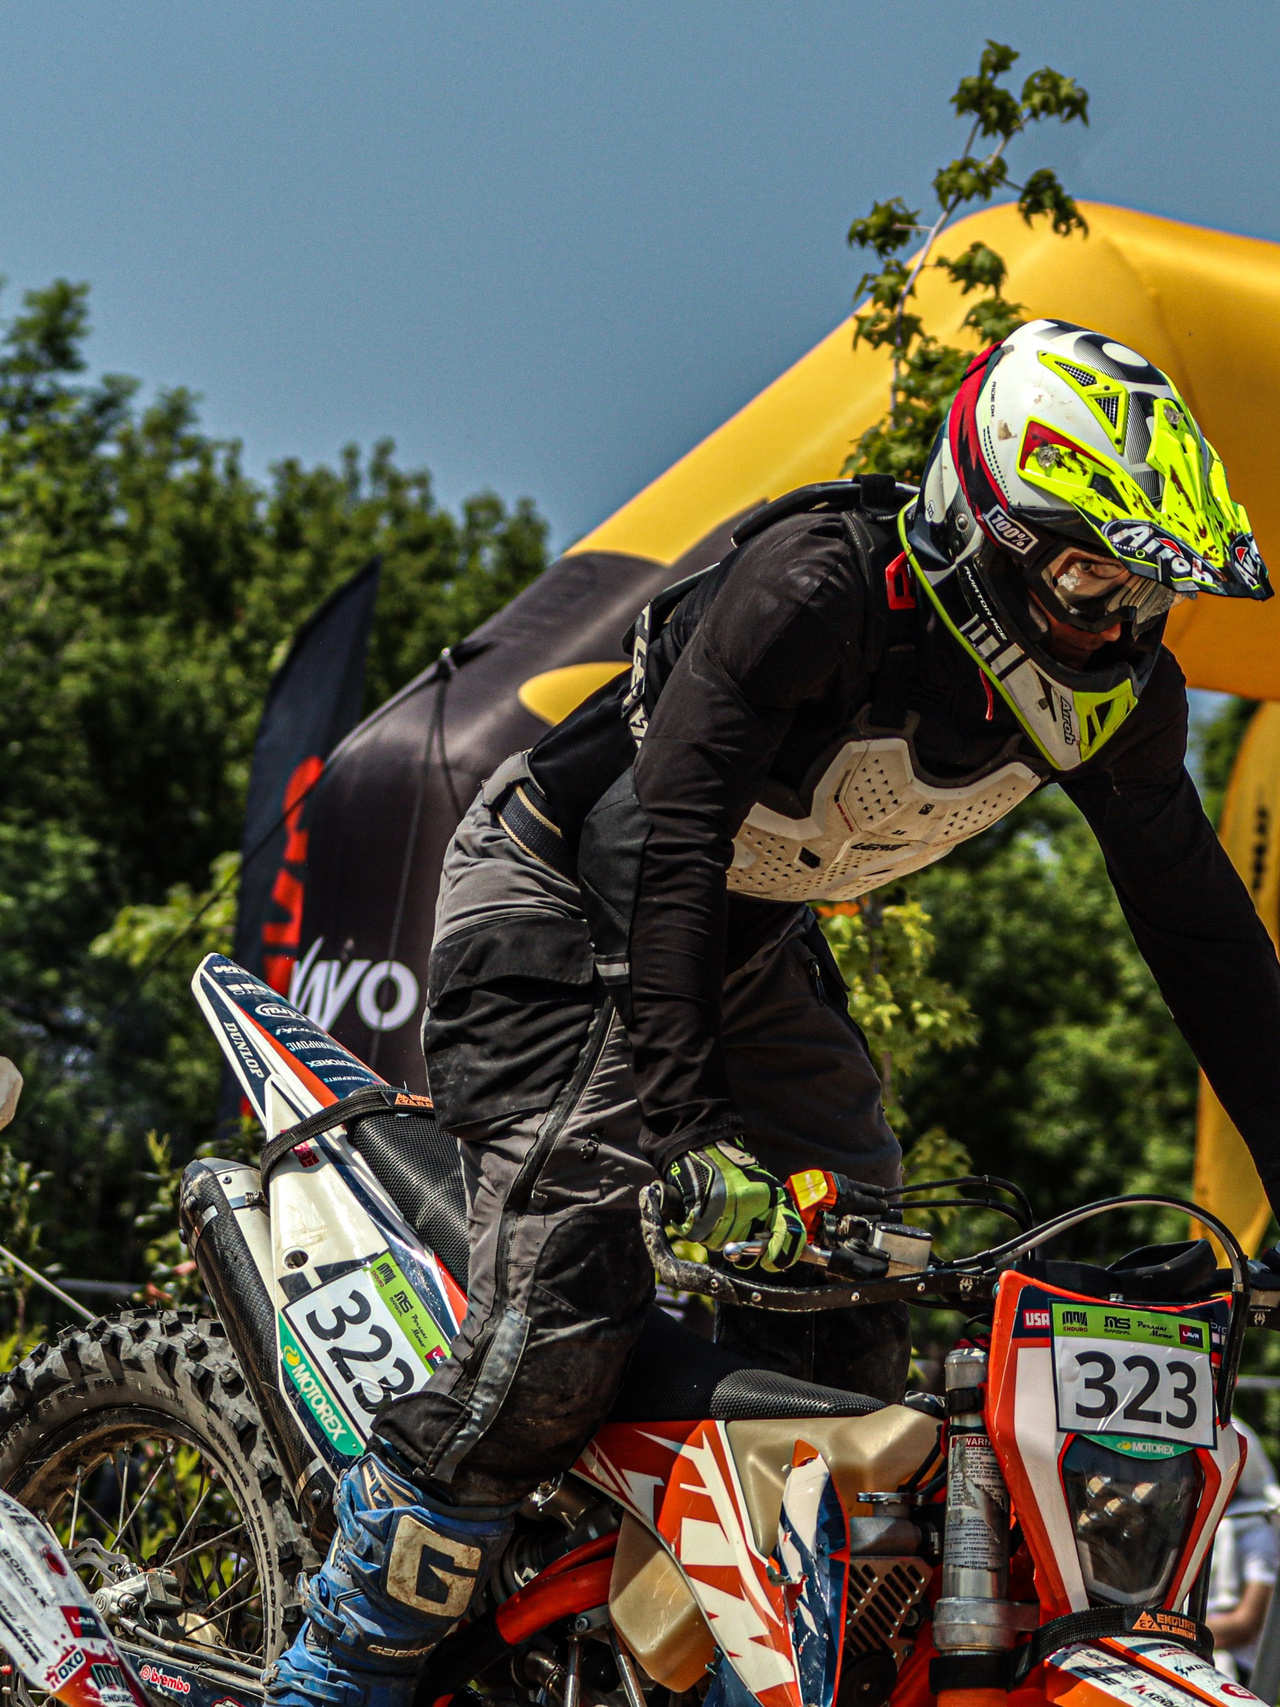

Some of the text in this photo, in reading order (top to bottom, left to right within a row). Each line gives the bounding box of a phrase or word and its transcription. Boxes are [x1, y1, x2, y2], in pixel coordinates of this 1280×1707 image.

[991, 512, 1031, 551] 100%
[963, 564, 993, 617] AVIATOR
[989, 616, 1008, 641] ACE
[1059, 694, 1076, 746] Airoh
[223, 1022, 266, 1079] DUNLOP
[1025, 1313, 1050, 1326] USA
[1104, 1316, 1131, 1330] MS
[1182, 1330, 1200, 1339] LAVR
[306, 1290, 415, 1416] 323
[291, 1363, 348, 1442] MOTOREX
[1075, 1350, 1198, 1430] 323
[1132, 1441, 1176, 1457] MOTOREX
[2, 1549, 50, 1608] ФОРСАЖ
[386, 1514, 482, 1618] G
[70, 1615, 97, 1627] LAVR
[1156, 1613, 1197, 1633] ENDURO
[1161, 1624, 1198, 1642] ELEMENT
[150, 1668, 191, 1694] brembo
[100, 1691, 136, 1704] ENDURO
